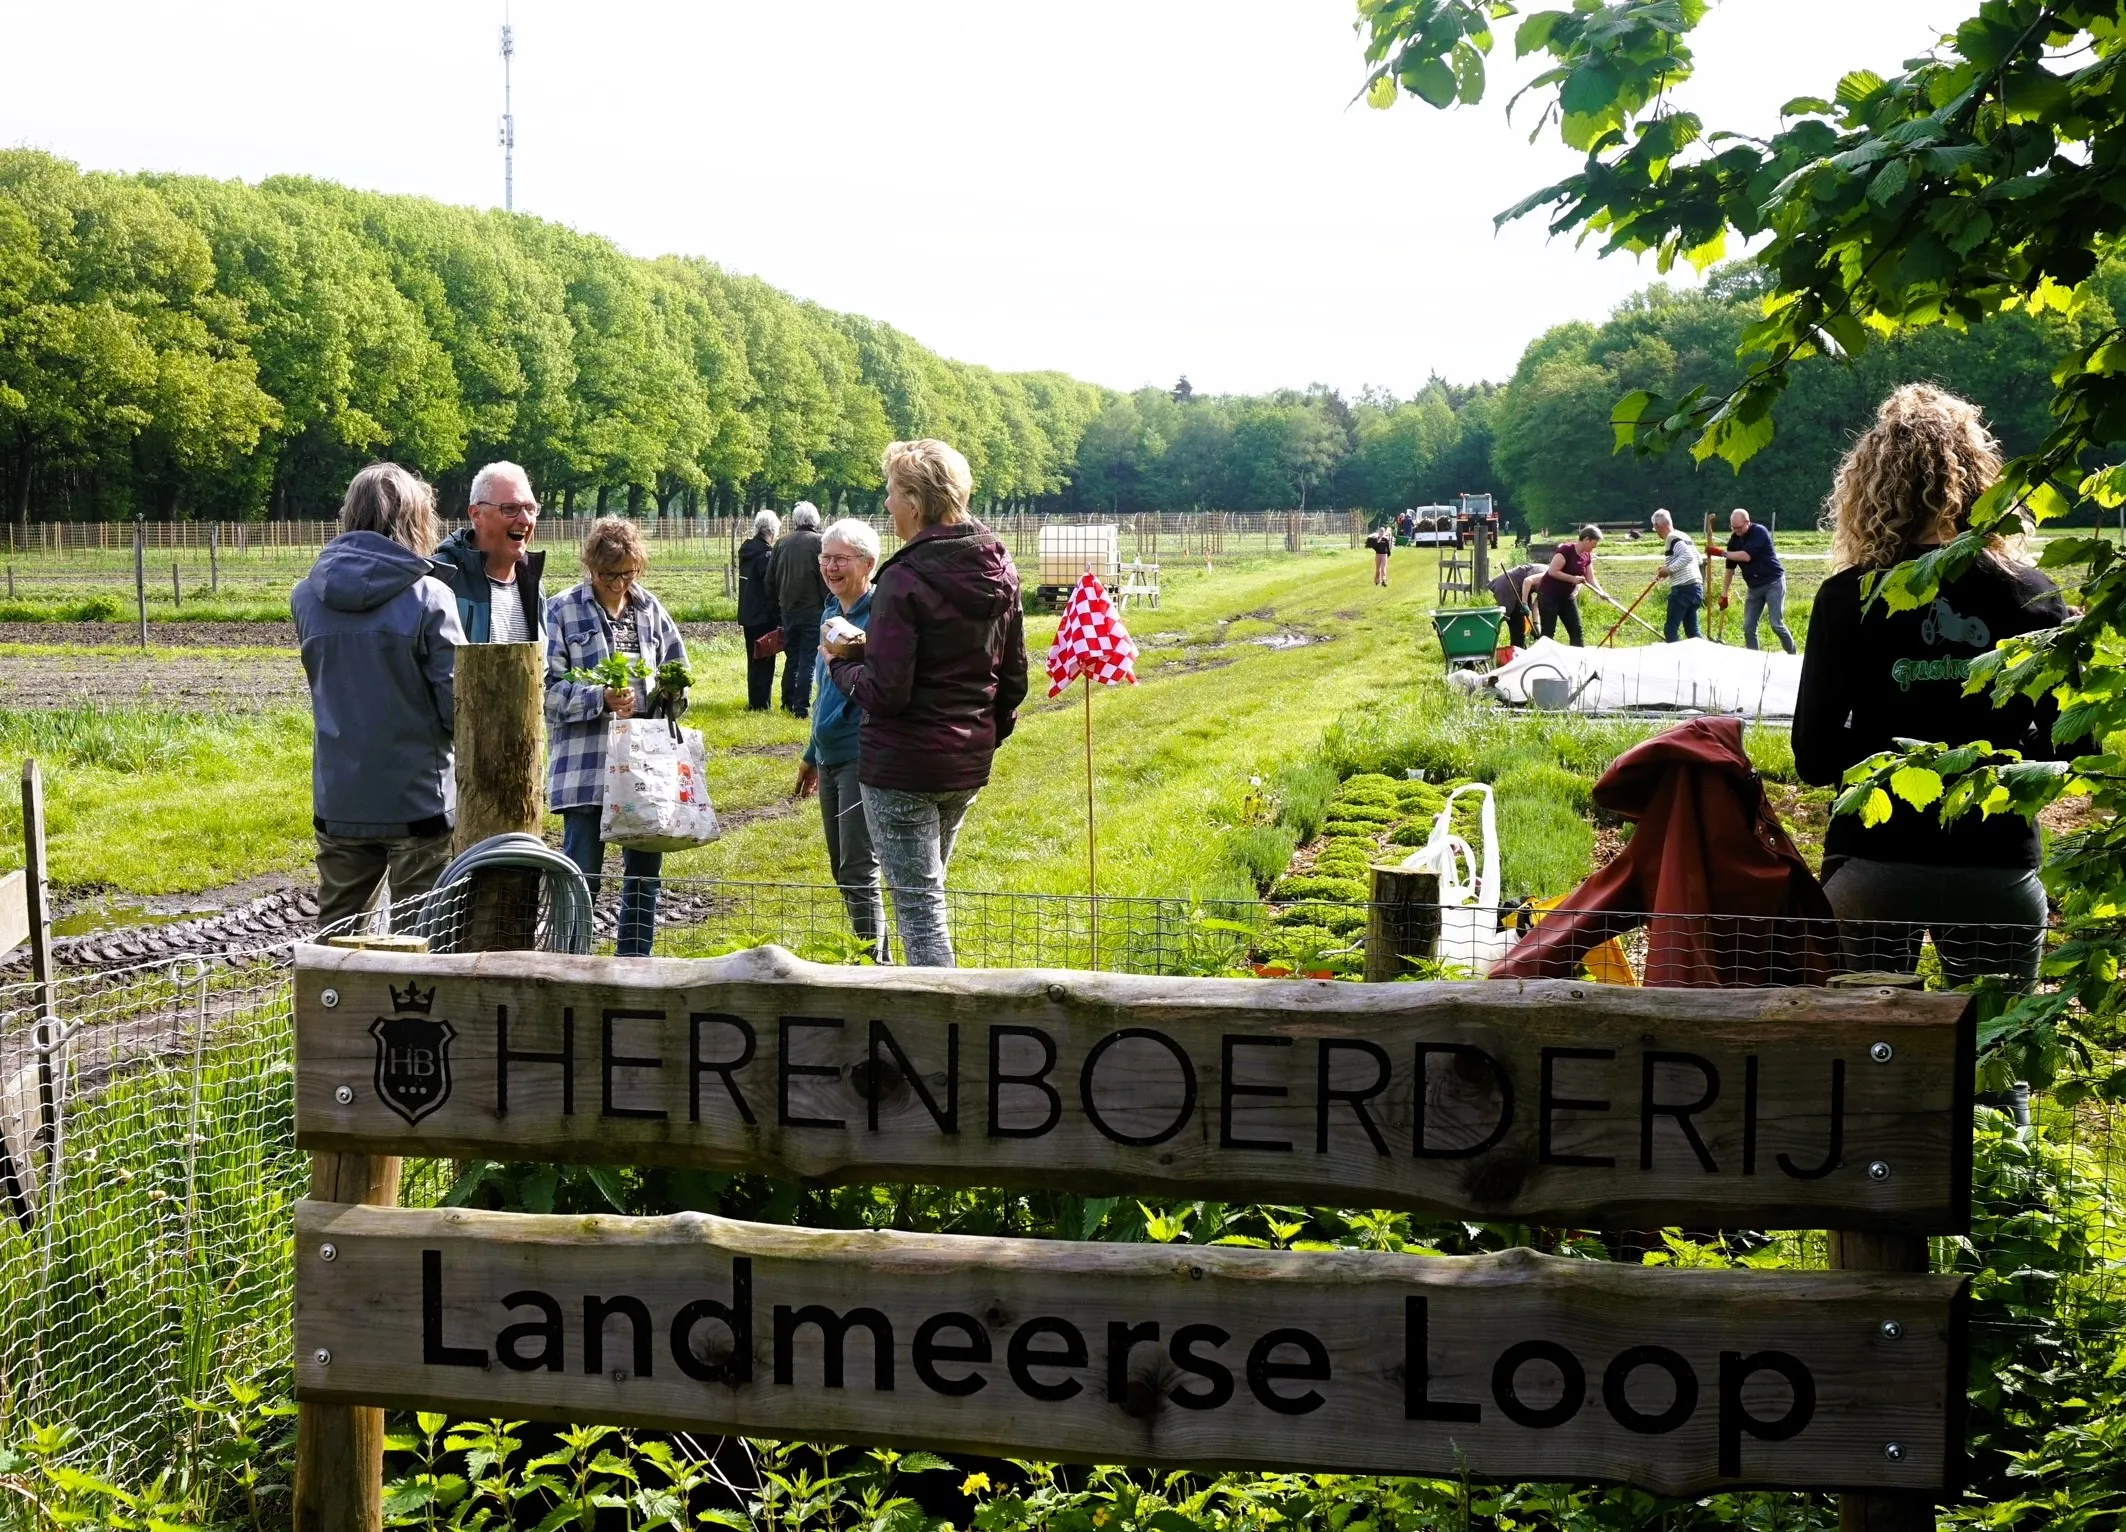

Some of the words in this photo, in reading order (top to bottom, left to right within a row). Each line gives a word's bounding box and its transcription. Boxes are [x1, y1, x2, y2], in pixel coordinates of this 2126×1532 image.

[390, 1047, 435, 1077] HB
[496, 1003, 1846, 1181] HERENBOERDERIJ
[421, 1249, 1332, 1416] Landmeerse
[1403, 1295, 1817, 1479] Loop
